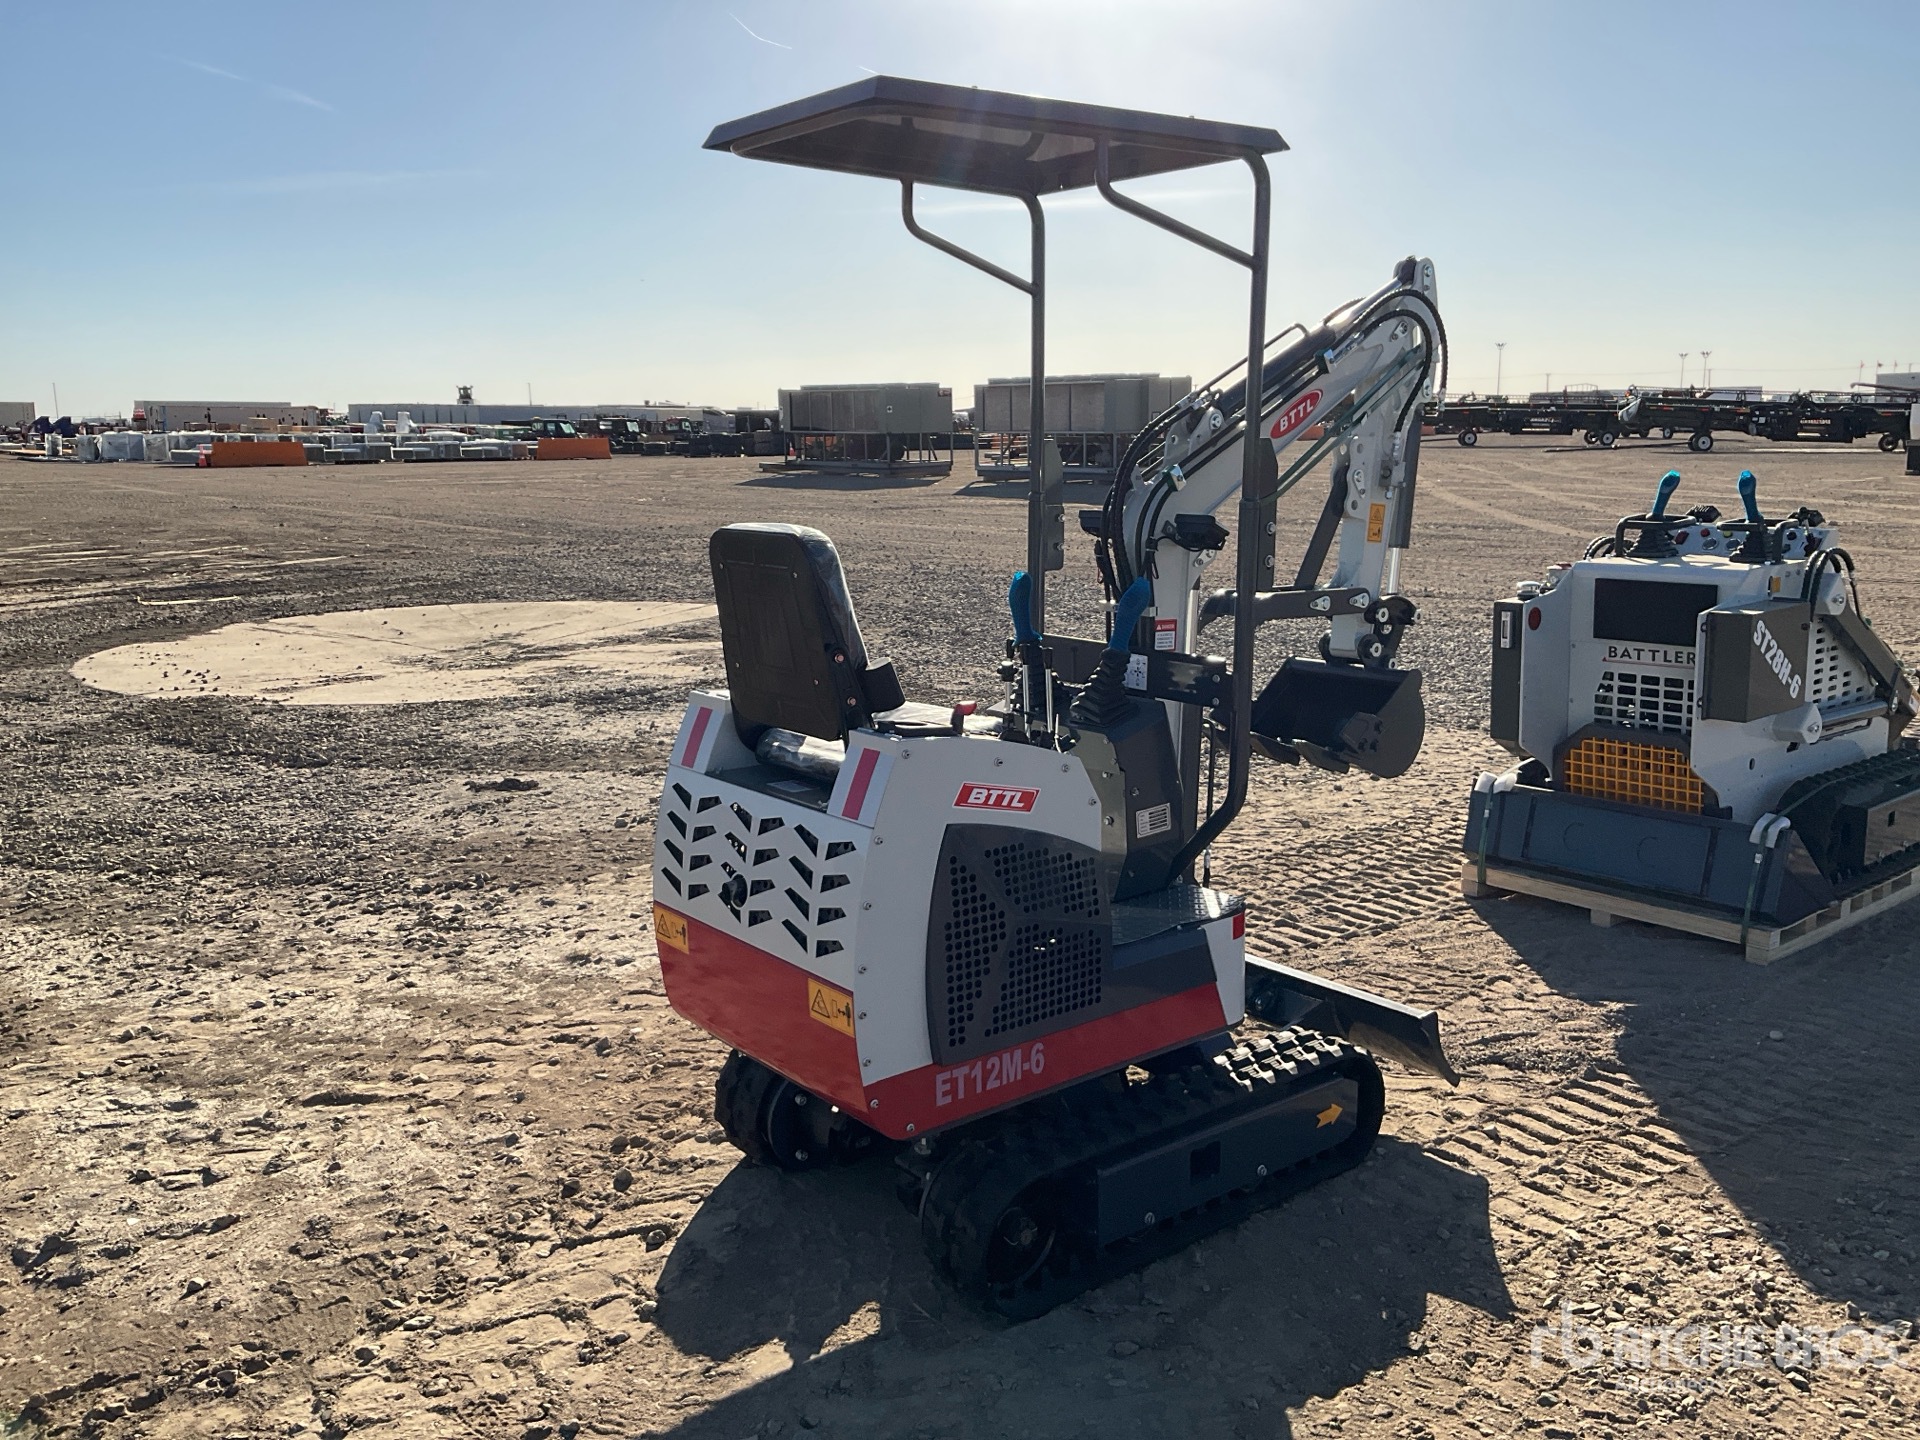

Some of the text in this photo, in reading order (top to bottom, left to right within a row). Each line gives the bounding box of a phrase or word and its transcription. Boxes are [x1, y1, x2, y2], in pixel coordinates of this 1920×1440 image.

[1280, 399, 1314, 432] BTTL
[1608, 645, 1695, 666] BATTLER
[1753, 620, 1802, 698] ST28H-6
[967, 787, 1025, 808] BTTL
[935, 1042, 1045, 1107] ET12M-6
